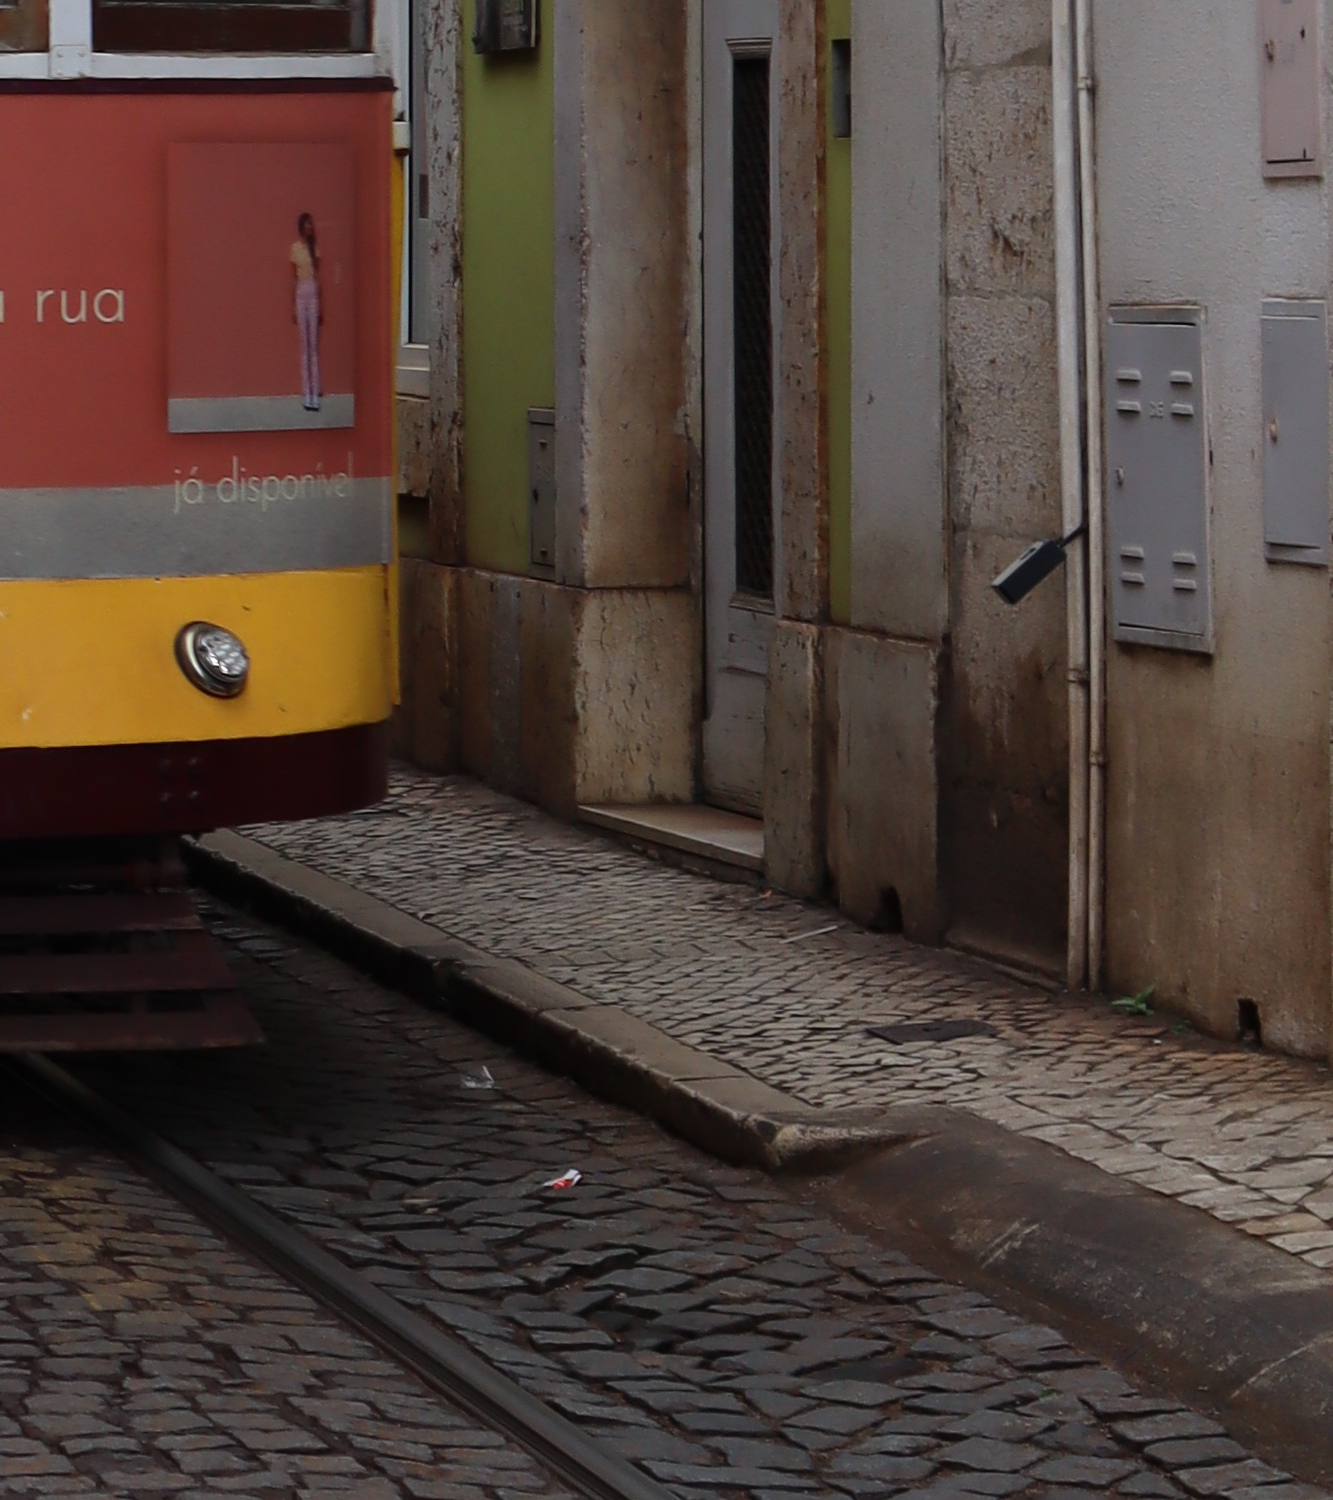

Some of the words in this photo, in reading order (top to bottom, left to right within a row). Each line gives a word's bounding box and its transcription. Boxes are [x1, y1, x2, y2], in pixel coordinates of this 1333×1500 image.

[36, 287, 126, 324] rua
[173, 465, 205, 515] já
[216, 450, 355, 513] disponível
